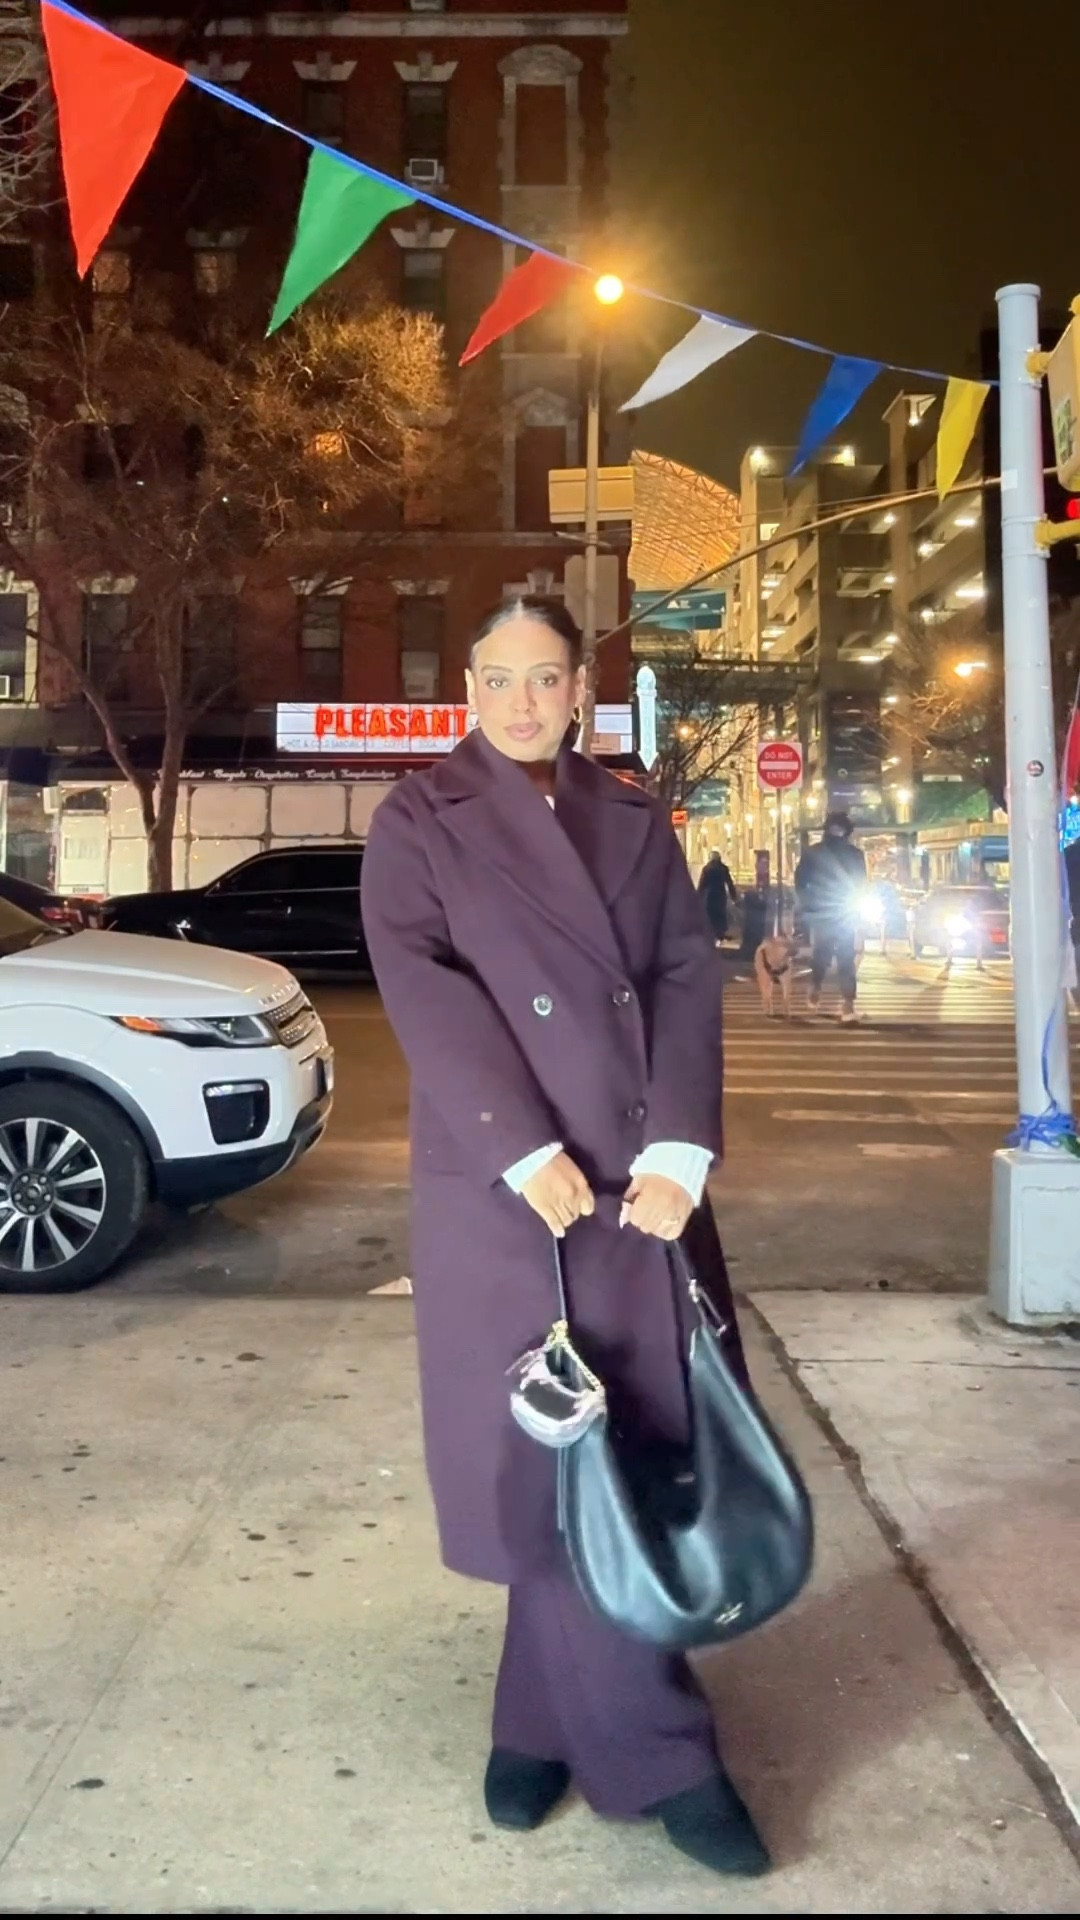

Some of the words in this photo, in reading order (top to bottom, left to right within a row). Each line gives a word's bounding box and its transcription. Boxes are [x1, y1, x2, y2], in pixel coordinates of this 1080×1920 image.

[316, 709, 468, 737] PLEASANT
[764, 751, 777, 760] DO
[778, 751, 793, 760] NOT
[766, 771, 793, 780] ENTER
